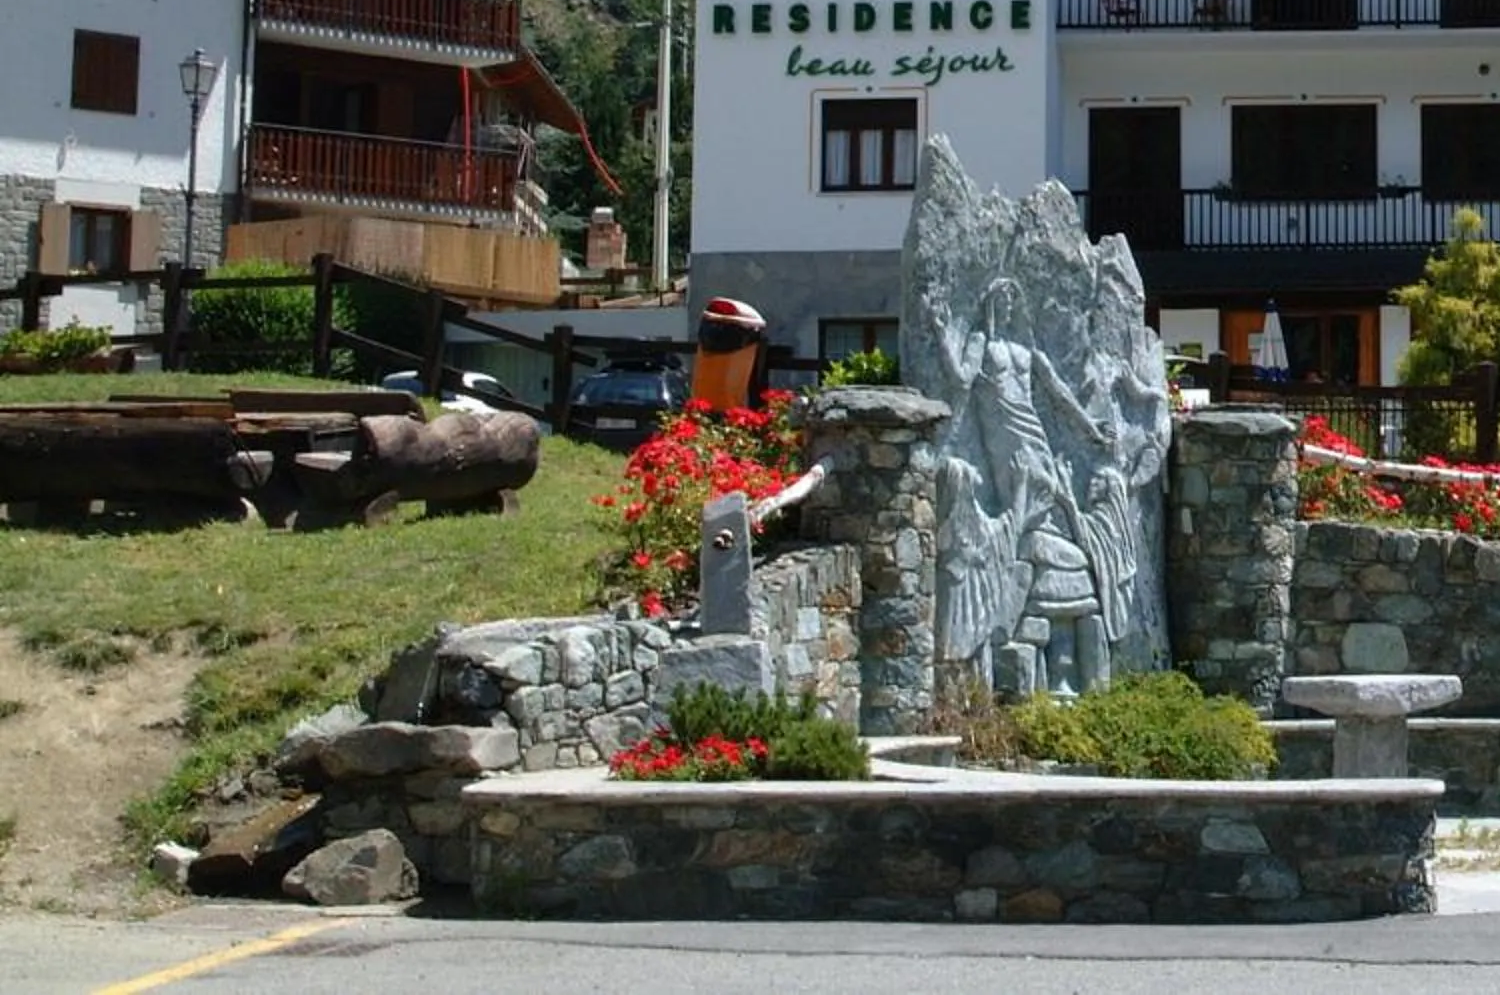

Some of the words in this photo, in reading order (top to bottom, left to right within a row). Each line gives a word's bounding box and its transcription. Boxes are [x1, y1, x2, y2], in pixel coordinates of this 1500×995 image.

[712, 0, 1032, 34] RESIDENCE
[785, 45, 875, 77] beau
[890, 46, 1015, 86] séjour
